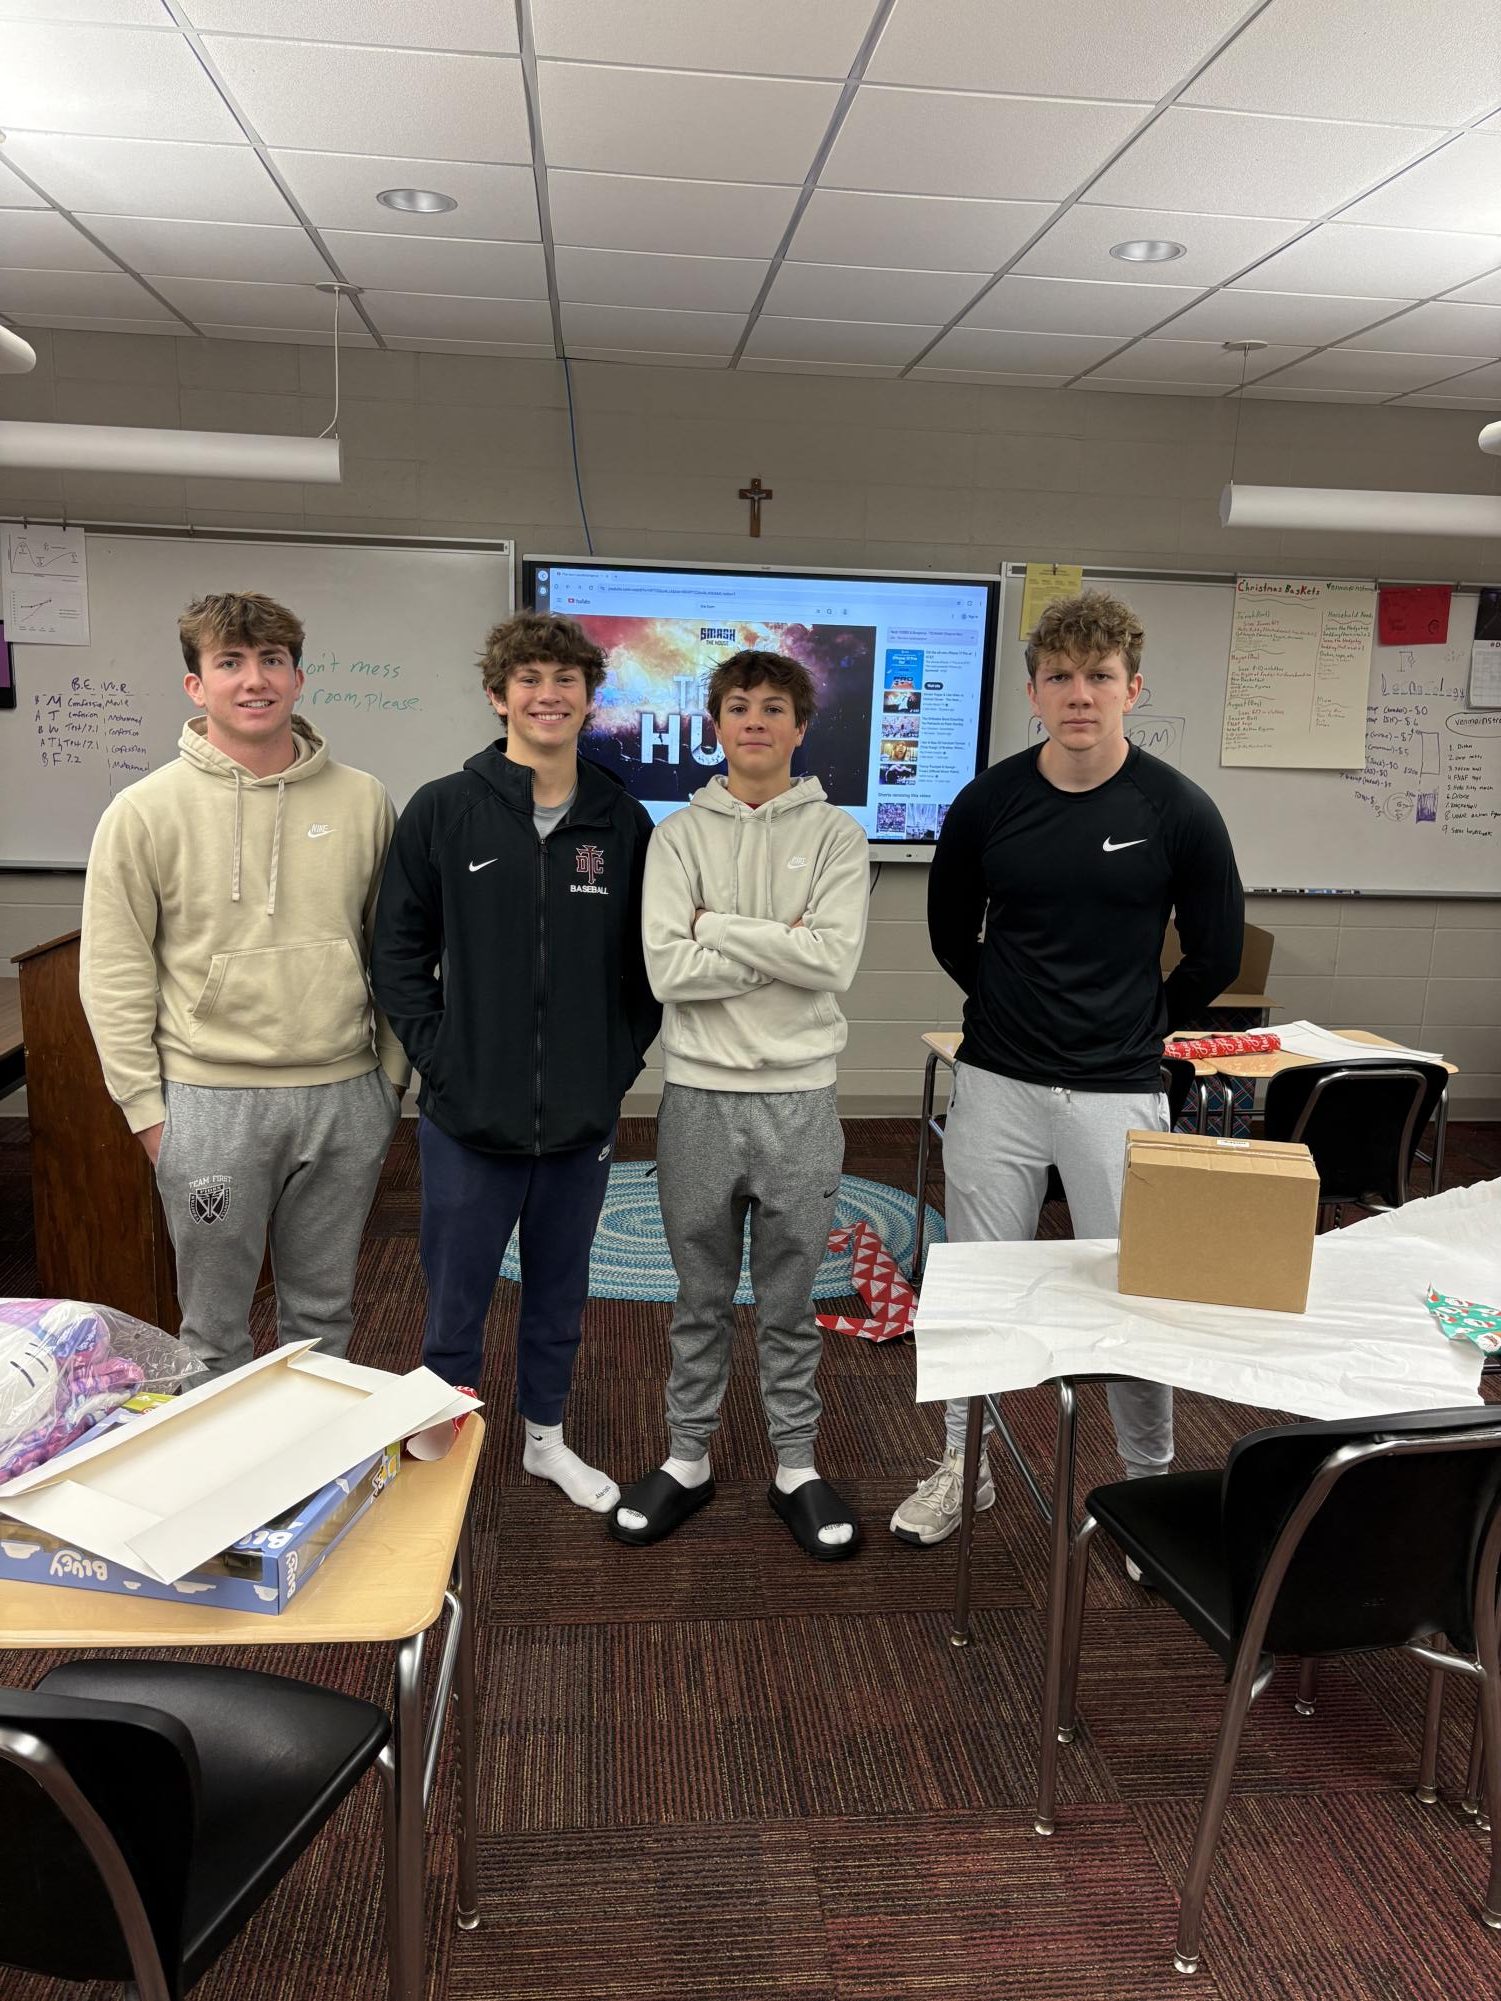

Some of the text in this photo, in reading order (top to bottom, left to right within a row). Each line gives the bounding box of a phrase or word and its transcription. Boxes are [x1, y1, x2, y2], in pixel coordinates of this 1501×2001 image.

[1238, 580, 1282, 593] Christmas
[700, 627, 736, 642] SMASH
[350, 660, 401, 679] mess
[46, 695, 62, 707] M
[52, 752, 62, 766] F
[66, 753, 81, 764] 7.2
[309, 823, 329, 833] NIKE
[570, 884, 609, 895] BASEBALL
[189, 1175, 210, 1189] TEAM
